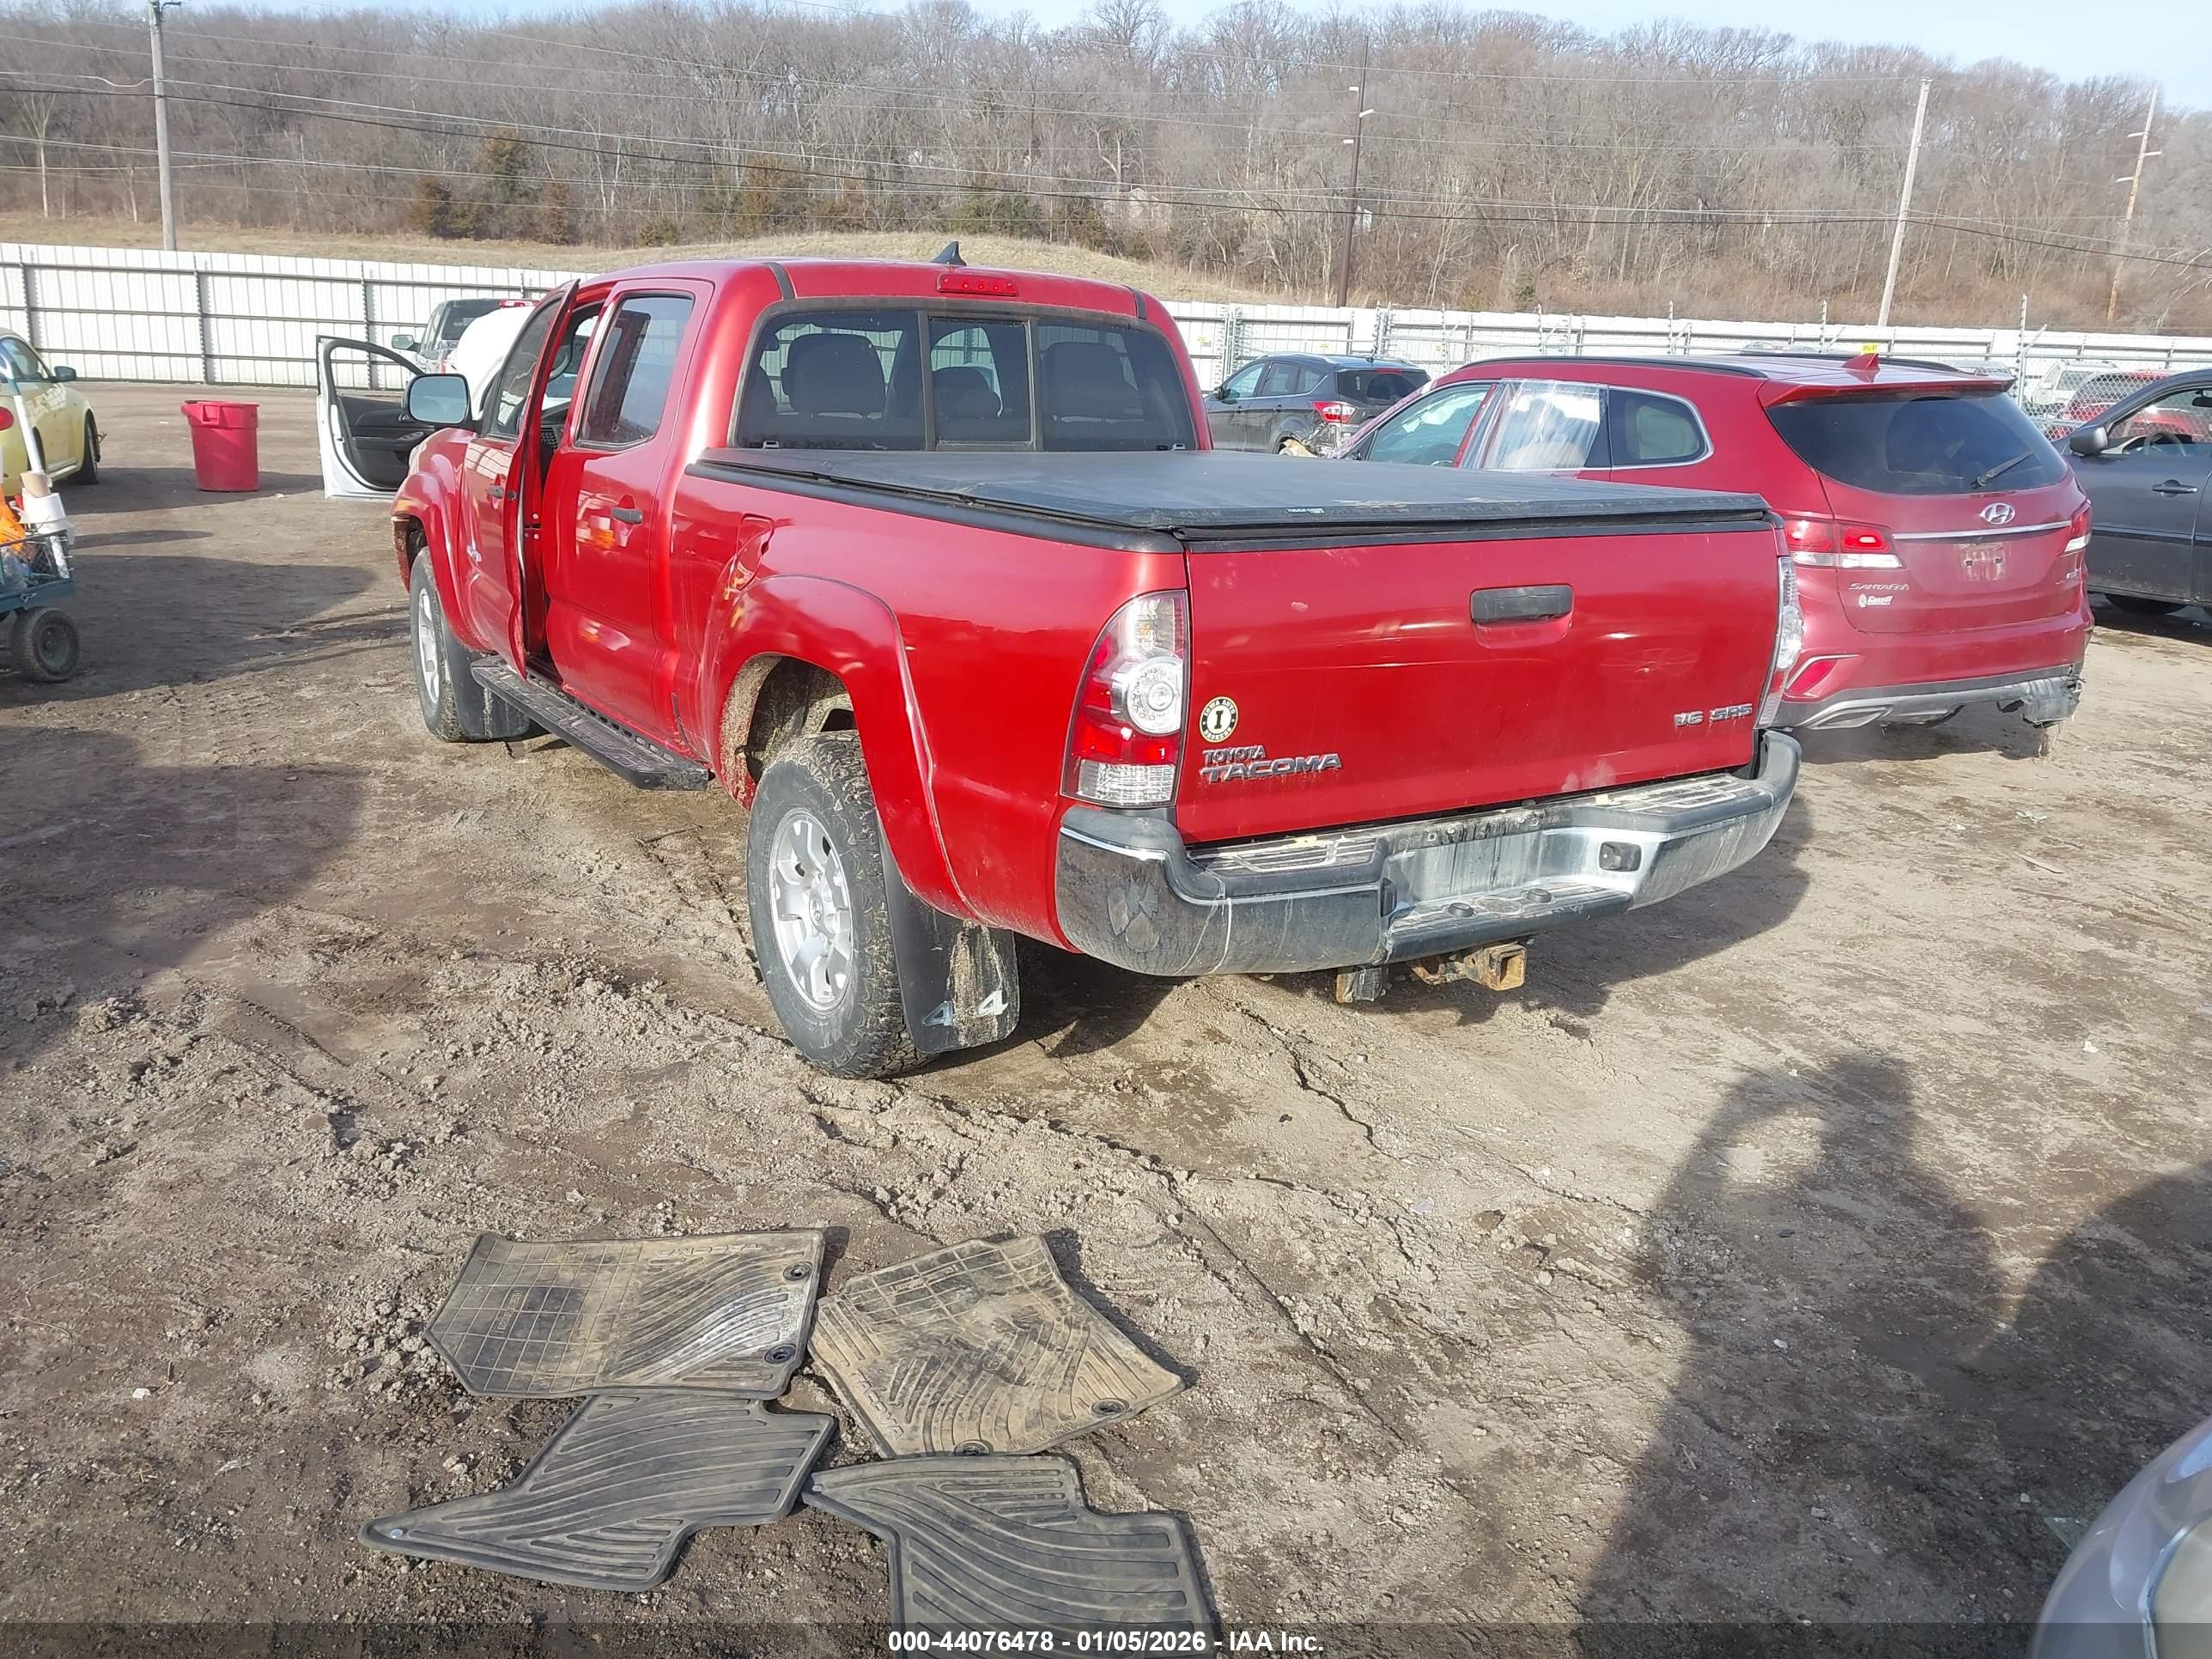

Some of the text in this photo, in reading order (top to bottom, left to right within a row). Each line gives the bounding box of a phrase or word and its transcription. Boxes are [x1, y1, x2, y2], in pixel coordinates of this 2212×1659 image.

[1203, 699, 1236, 716] IOWA AUTO
[1214, 710, 1224, 729] I
[1202, 744, 1267, 763] TOYOTA
[1200, 753, 1342, 783] TACOMA
